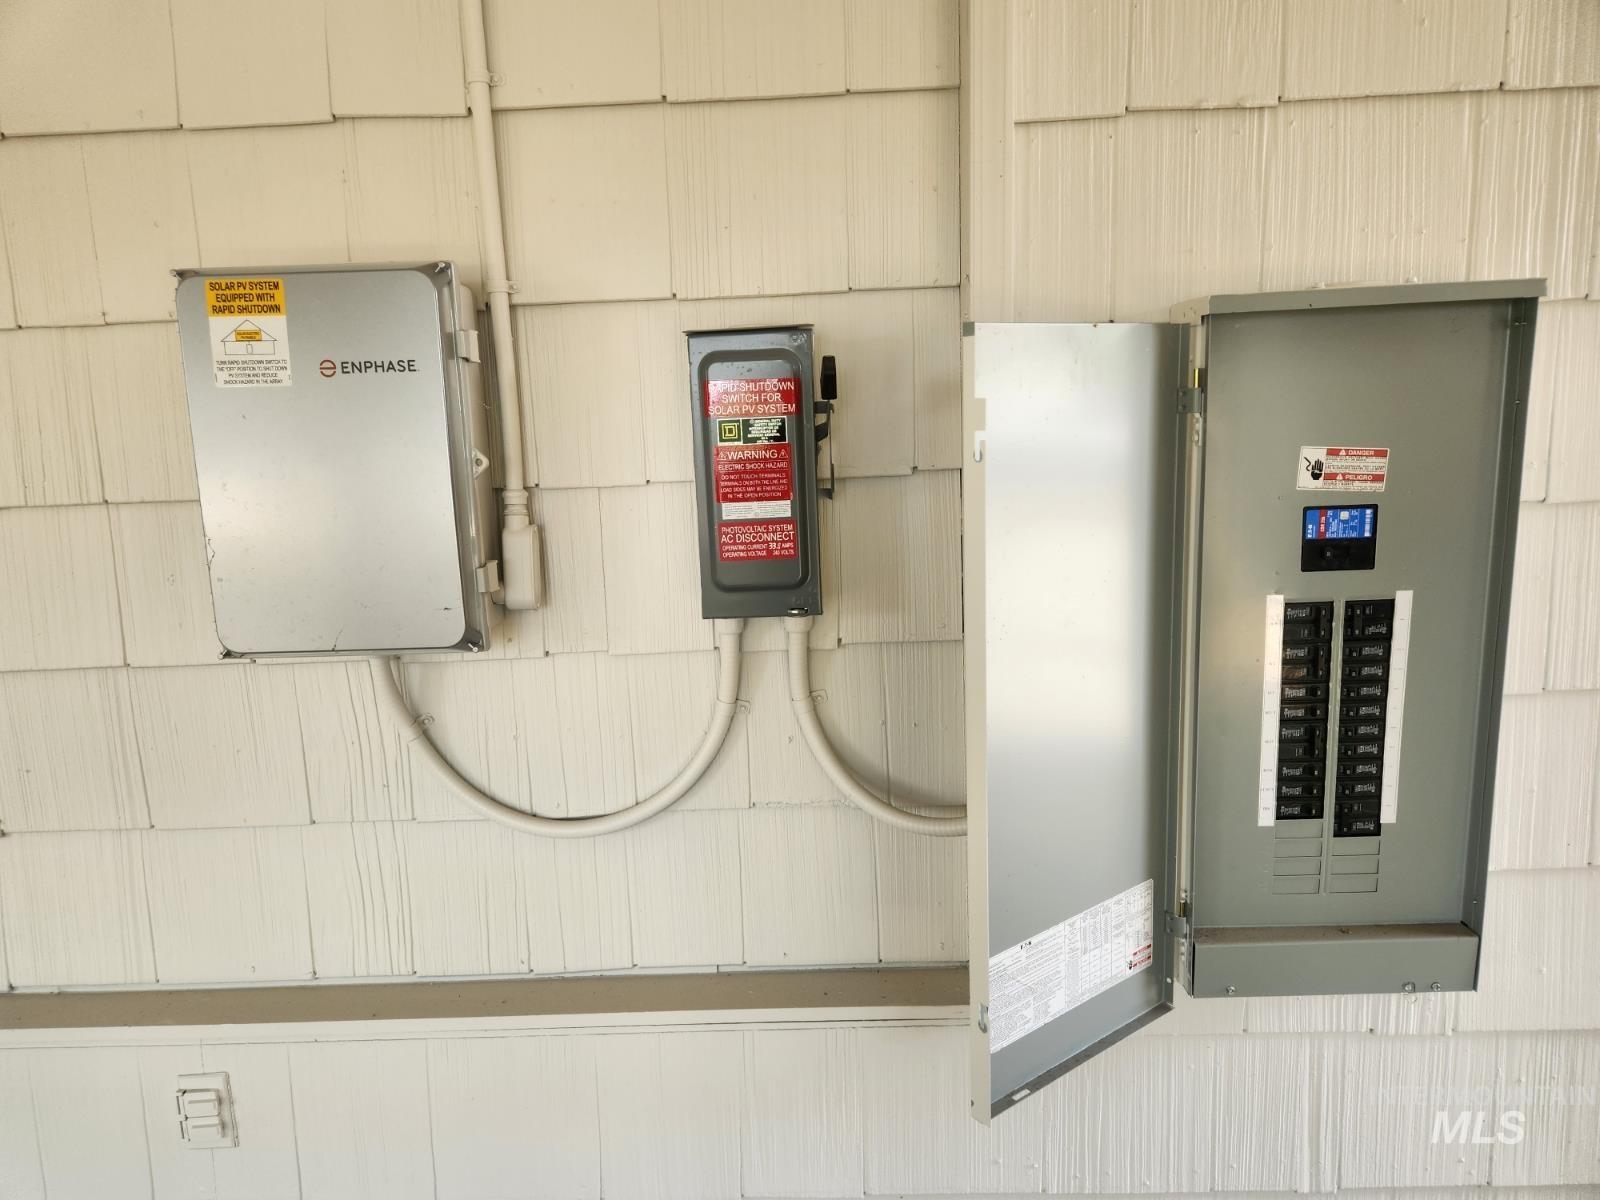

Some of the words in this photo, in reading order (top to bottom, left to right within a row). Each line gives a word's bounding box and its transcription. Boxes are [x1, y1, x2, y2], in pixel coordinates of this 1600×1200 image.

[209, 282, 235, 291] SOLAR
[237, 282, 246, 290] PV
[249, 281, 279, 290] SYSTEM
[216, 293, 254, 302] EQUIPPED
[256, 293, 275, 302] WITH
[212, 305, 235, 314] RAPID
[237, 304, 281, 313] SHUTDOWN
[341, 360, 417, 374] ENPHASE
[740, 382, 794, 392] SHUTDOWN
[722, 394, 758, 403] SWITCH
[762, 393, 782, 402] FOR
[709, 406, 739, 415] SOLAR
[742, 405, 754, 414] PV
[758, 404, 795, 413] SYSTEM
[727, 450, 778, 460] WARNING
[722, 525, 767, 534] PHOTOVOLTAIC
[721, 535, 734, 543] AC
[736, 532, 794, 543] DISCONNECT
